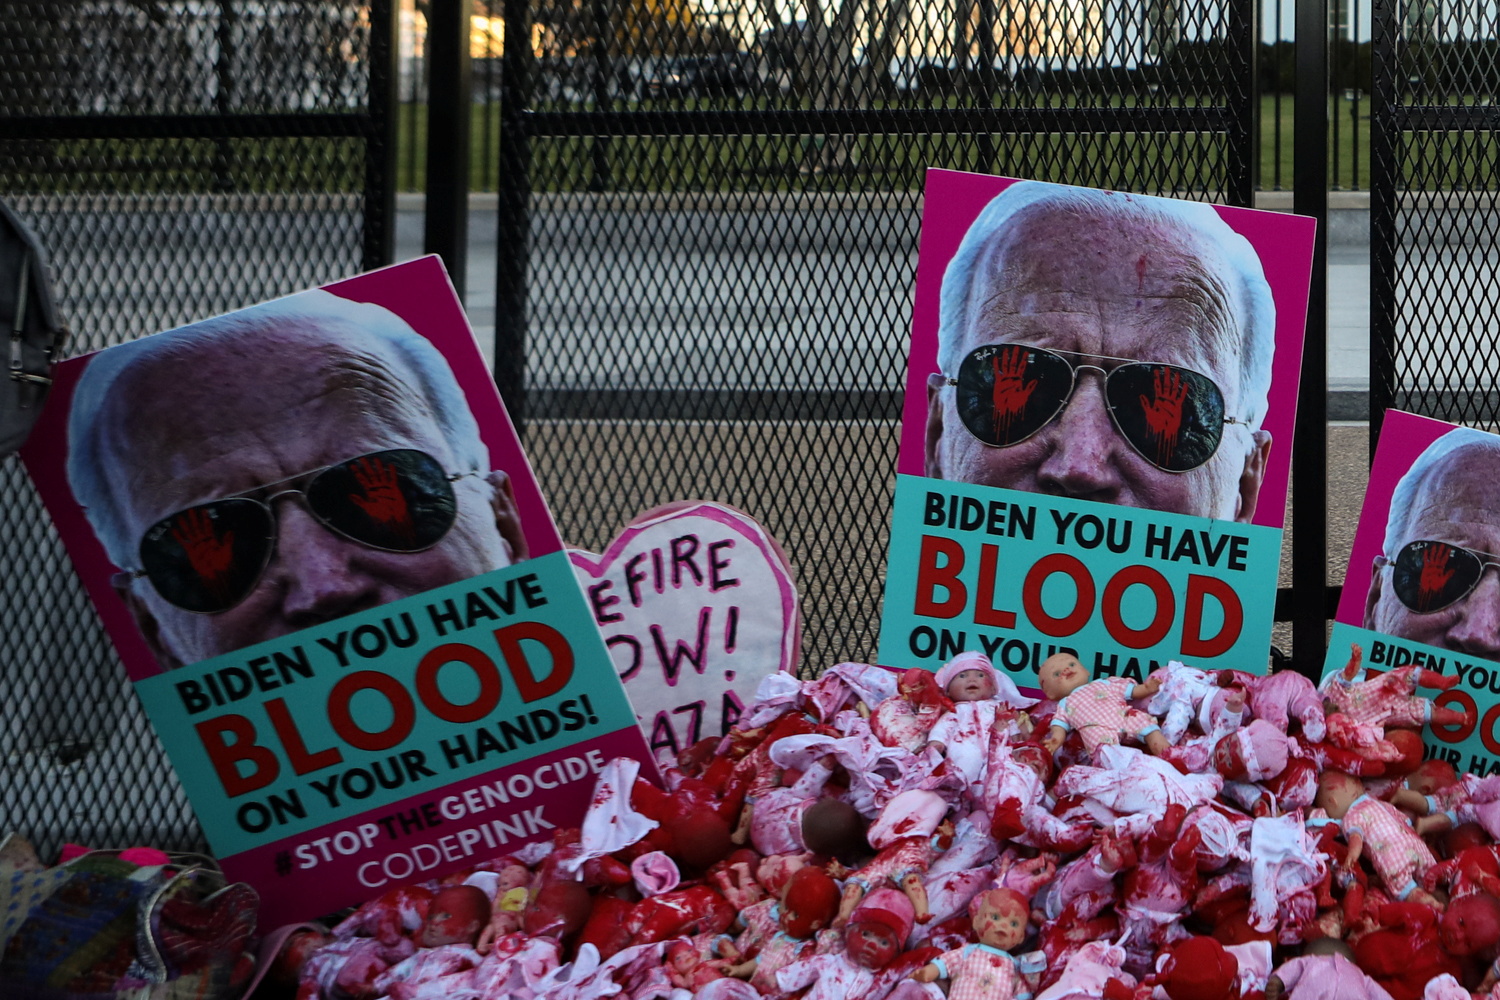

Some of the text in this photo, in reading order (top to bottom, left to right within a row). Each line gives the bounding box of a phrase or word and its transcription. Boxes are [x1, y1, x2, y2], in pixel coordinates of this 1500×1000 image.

[923, 491, 1250, 572] BIDEN YOU HAVE
[588, 533, 741, 627] EFIRE
[914, 534, 1244, 659] BLOOD
[174, 572, 548, 716] BIDEN YOU HAVE
[605, 606, 740, 687] OW!
[909, 625, 967, 662] ON
[1369, 640, 1447, 677] BIDEN
[194, 620, 575, 799] BLOOD
[648, 689, 746, 761] AZA
[236, 693, 600, 834] ON YOUR HANDS!
[357, 805, 557, 889] CODEPINK
